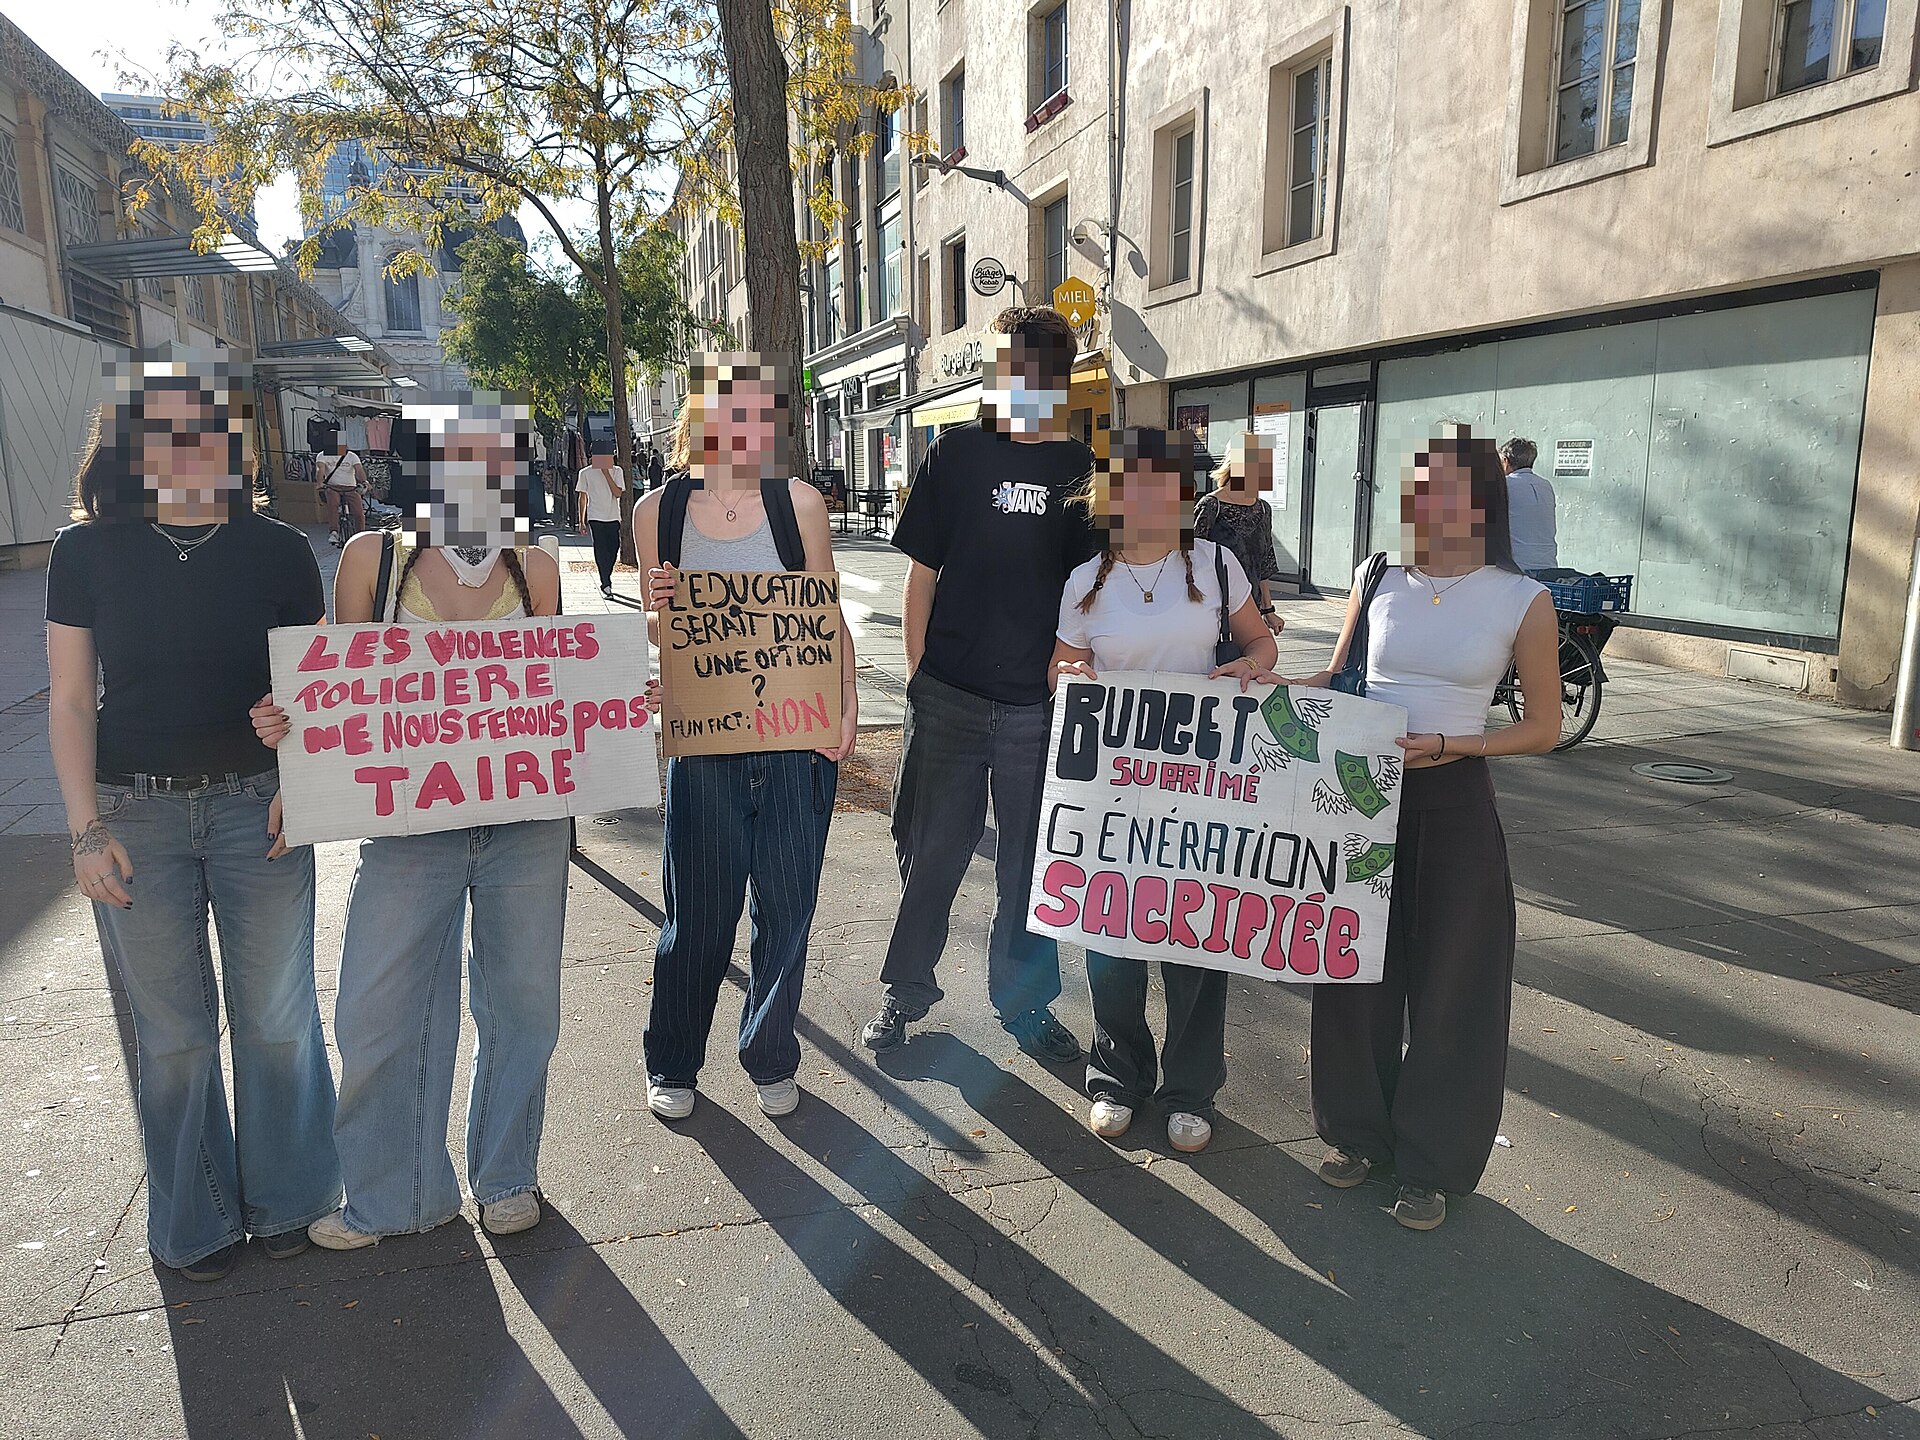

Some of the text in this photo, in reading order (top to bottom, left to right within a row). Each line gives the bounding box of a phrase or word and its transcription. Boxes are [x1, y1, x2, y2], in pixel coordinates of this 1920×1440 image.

[974, 267, 1003, 280] Burger
[1058, 290, 1090, 304] MIEL
[940, 351, 965, 375] Burger
[1007, 483, 1047, 516] VANS
[297, 622, 600, 672] LES VIOLENCES
[671, 606, 836, 650] SERAIT DONC
[694, 644, 833, 678] UNE OPTION
[294, 663, 554, 712] POLICIERE
[751, 674, 766, 707] ?
[303, 696, 649, 755] NE NOUS FERONS pas
[669, 720, 703, 739] FUN
[754, 692, 831, 743] NON
[1056, 683, 1260, 781] BUDGET
[354, 749, 576, 817] TAIRE
[1046, 797, 1338, 894] GÉNÉRATION
[1034, 860, 1360, 979] SACRIFIÉE
